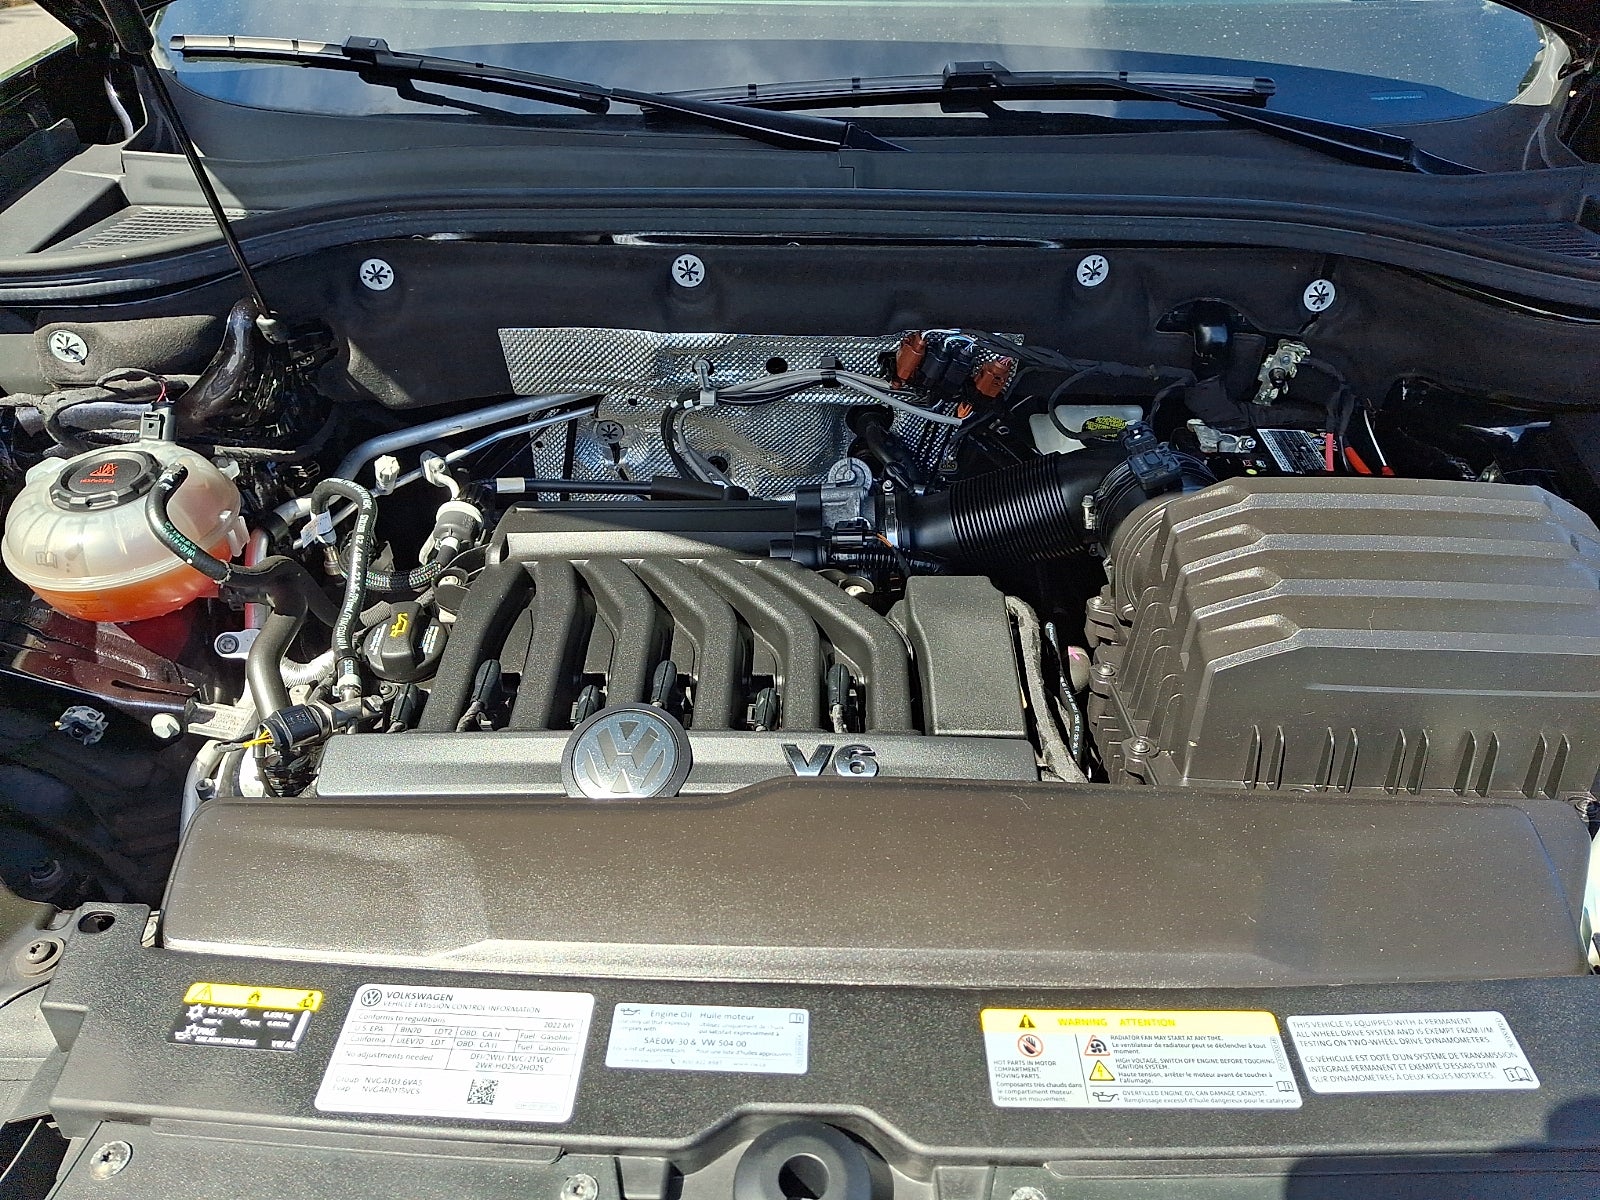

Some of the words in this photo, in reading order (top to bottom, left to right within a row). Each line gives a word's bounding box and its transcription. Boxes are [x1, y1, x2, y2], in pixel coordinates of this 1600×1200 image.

[781, 743, 879, 777] V6
[386, 991, 453, 1001] VOLKSWAGEN
[414, 1002, 450, 1010] EMISSION
[488, 1005, 540, 1013] INFORMATION
[358, 1012, 393, 1020] Conforms
[404, 1015, 446, 1023] regulations
[650, 1010, 679, 1019] Engine
[544, 1021, 560, 1029] 2022
[1058, 1018, 1108, 1026] WARNING
[1120, 1018, 1176, 1026] ATTENTION
[1311, 1020, 1344, 1028] VEHICLE
[1354, 1019, 1393, 1028] EQUIPPED
[1424, 1017, 1472, 1025] PERMANENT
[400, 1026, 422, 1034] BIN70
[482, 1030, 493, 1038] CA
[1341, 1029, 1365, 1037] DRIVE
[1397, 1028, 1415, 1036] AND
[1425, 1027, 1455, 1035] EXEMPT
[1456, 1026, 1480, 1034] FROM
[540, 1033, 572, 1041] Gasoline
[1333, 1039, 1347, 1047] ON
[1348, 1038, 1398, 1047] TWO-WHEEL
[1398, 1037, 1424, 1045] DRIVE
[538, 1044, 570, 1052] Gasoline
[690, 1038, 697, 1046] &
[701, 1038, 716, 1046] VW
[718, 1039, 734, 1047] 504
[735, 1040, 747, 1048] 00
[357, 1051, 404, 1060] adjustments
[405, 1053, 434, 1061] needed
[1392, 1053, 1414, 1061] D'UN
[1448, 1052, 1460, 1060] DE
[1459, 1051, 1518, 1060] TRANSMISSION
[1350, 1063, 1399, 1072] PERMANENT
[1398, 1063, 1408, 1071] ET
[1311, 1075, 1328, 1083] SUR
[1402, 1073, 1425, 1081] DEUX
[1426, 1072, 1454, 1080] ROUES
